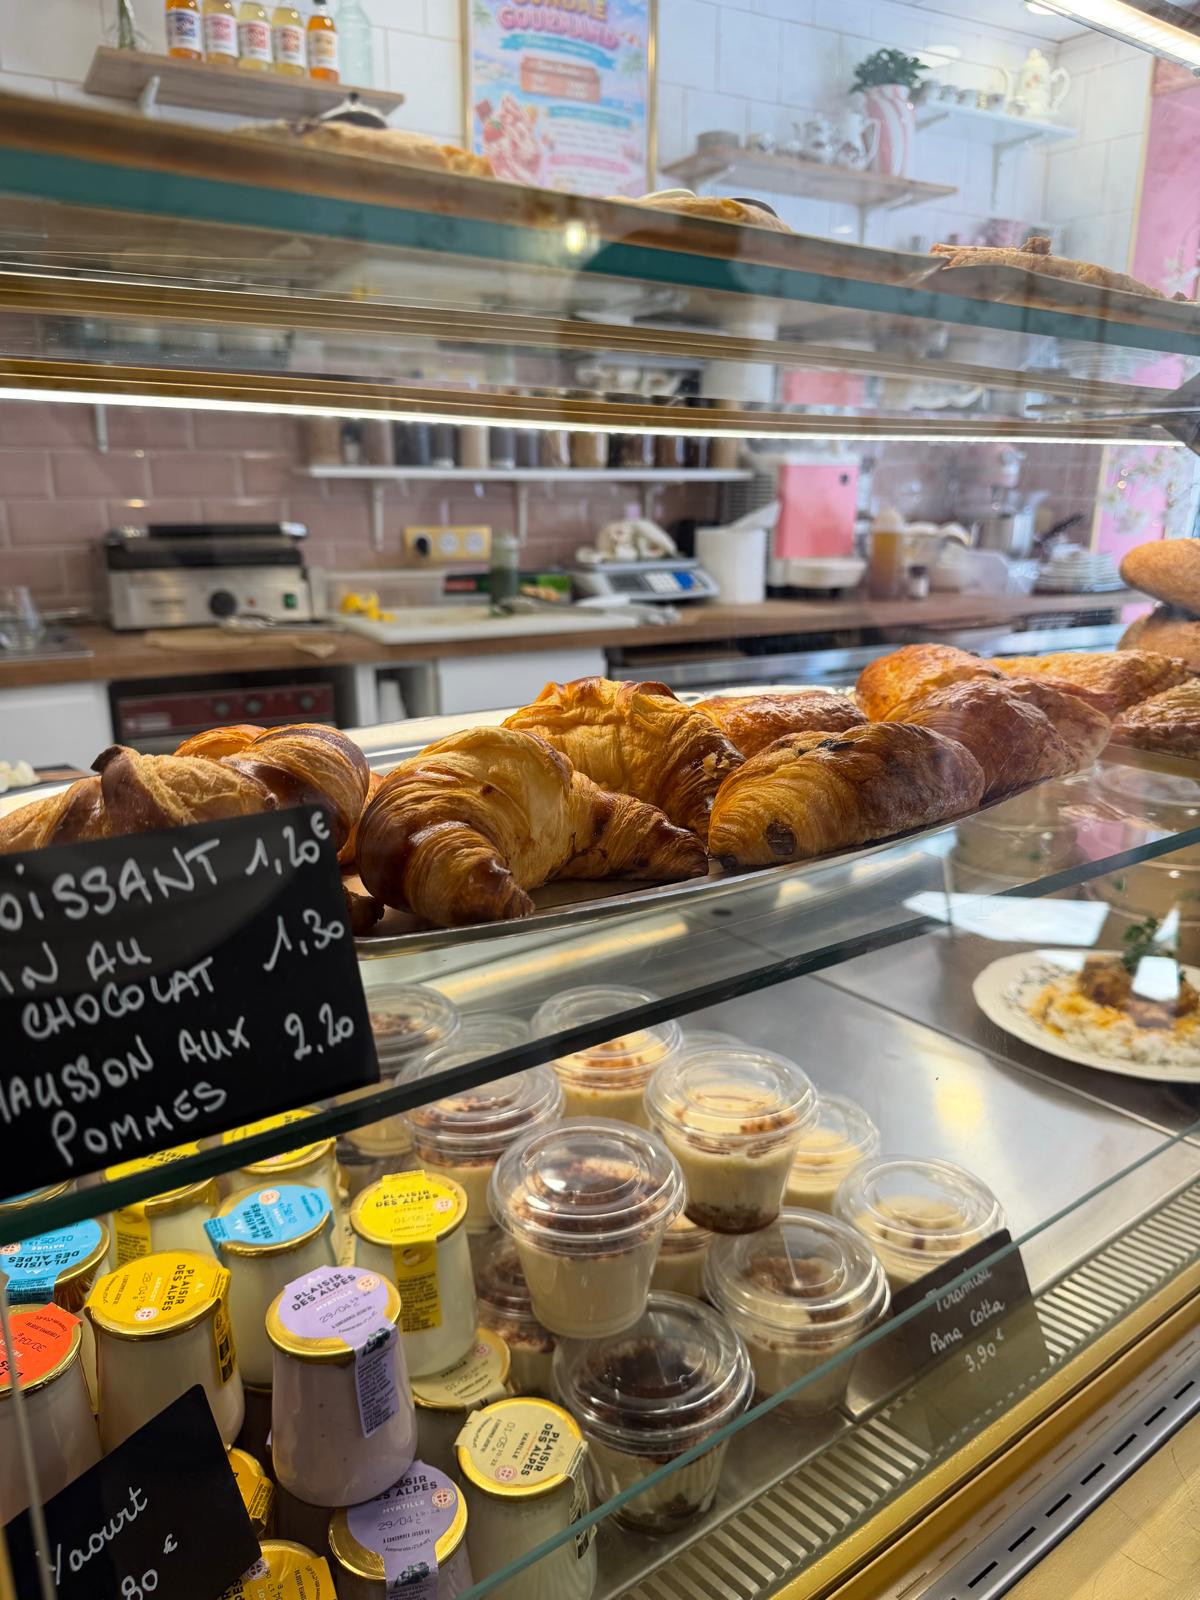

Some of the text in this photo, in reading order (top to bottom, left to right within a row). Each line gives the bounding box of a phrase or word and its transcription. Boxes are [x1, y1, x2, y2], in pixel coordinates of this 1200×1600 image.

[22, 908, 344, 1039] CHOCOLAT 1,30
[0, 1034, 153, 1123] AUSSON
[51, 1082, 227, 1167] POMMES
[376, 1193, 439, 1209] DES ALPES
[383, 1189, 430, 1200] PLAISIR
[8, 1250, 80, 1263] DES ALPES
[14, 1258, 69, 1269] PLAISIR
[162, 1264, 186, 1311] DES ALPES
[174, 1269, 195, 1305] PLAISIR
[292, 1274, 357, 1312] DES ALPES
[293, 1273, 343, 1301] PLAISIR
[930, 1299, 1005, 1354] Pana Cotta
[512, 1432, 530, 1459] VANILLE
[521, 1422, 554, 1476] DES ALPES
[534, 1431, 560, 1473] PLAISIR
[382, 1500, 425, 1514] MYRTILLE
[395, 1481, 438, 1497] ALPES
